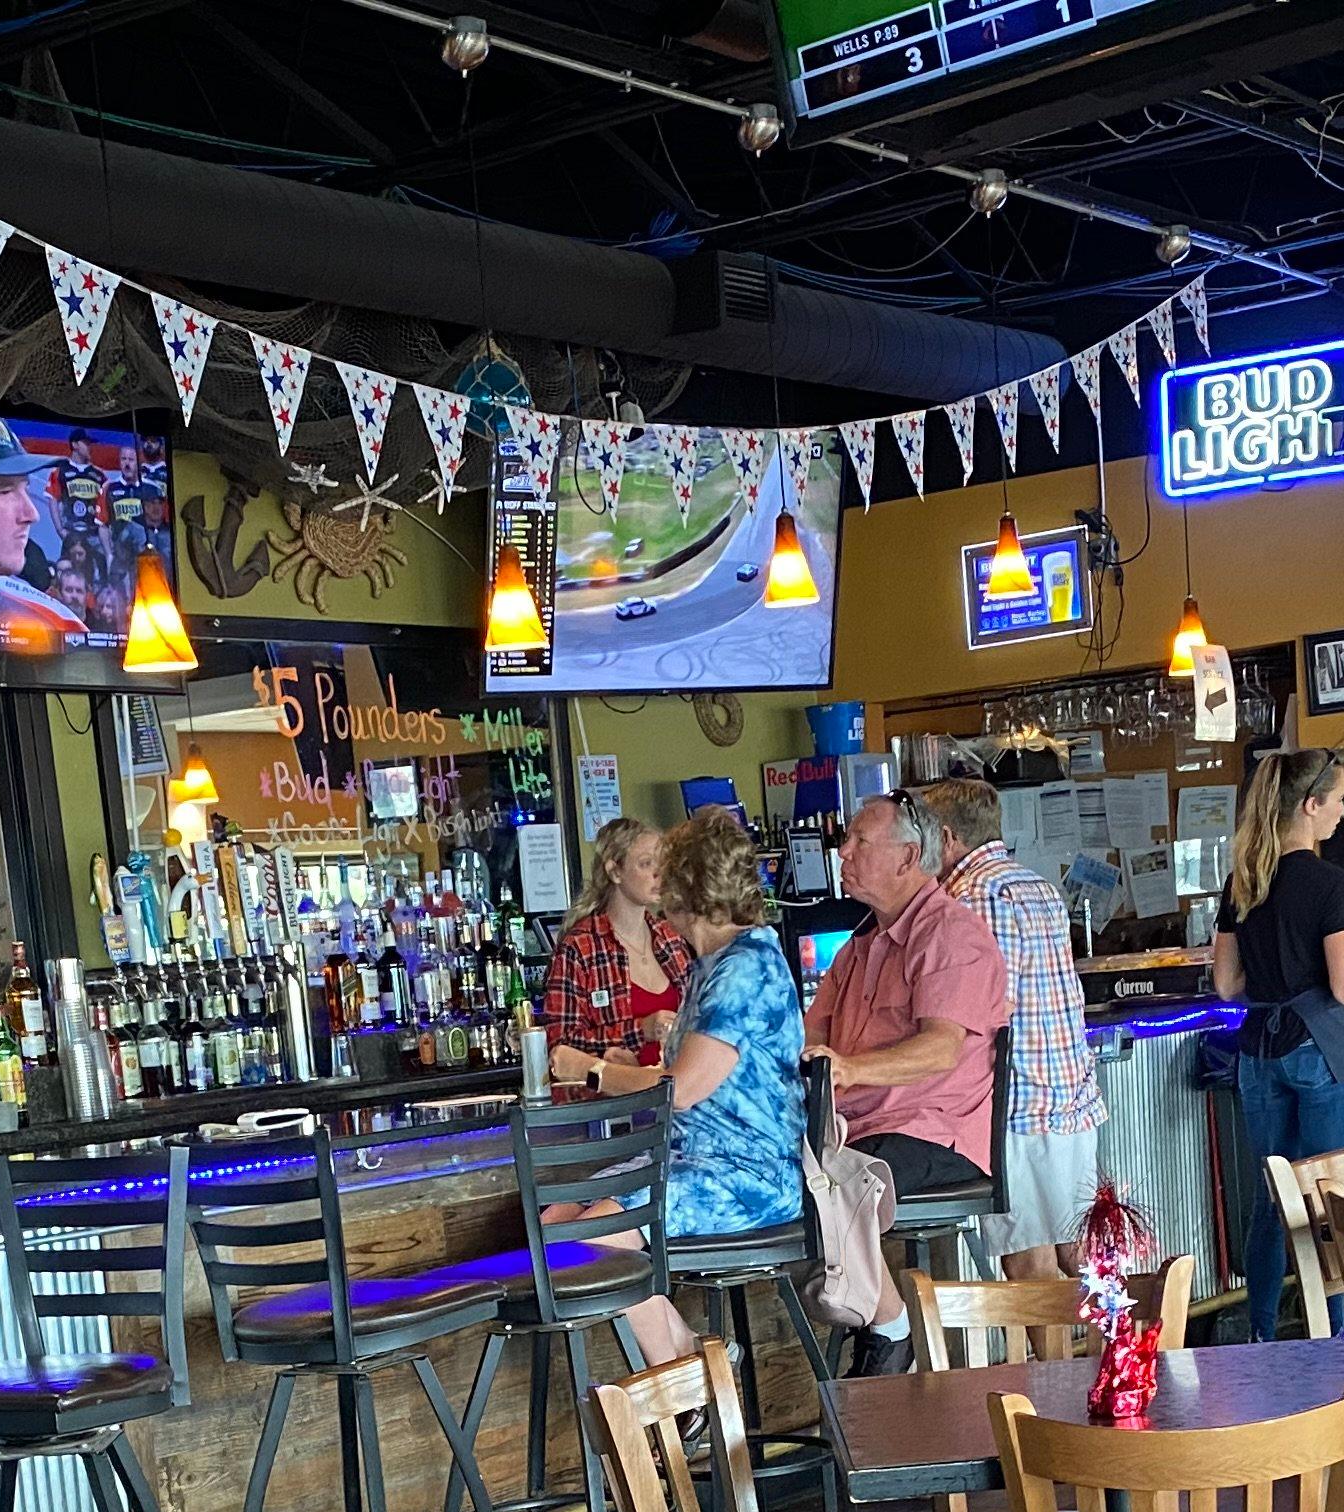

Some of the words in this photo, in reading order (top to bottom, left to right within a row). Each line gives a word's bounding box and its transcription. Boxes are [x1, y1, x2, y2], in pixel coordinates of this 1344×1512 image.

[833, 33, 869, 58] WELLS
[874, 24, 898, 44] P:89
[904, 46, 924, 73] 3
[1196, 358, 1333, 428] BUD
[252, 665, 304, 738] $5
[314, 671, 446, 744] Pounders
[482, 706, 546, 756] Miller
[273, 750, 332, 810] Bud
[765, 766, 799, 787] Red
[799, 757, 835, 780] Bull
[1114, 977, 1154, 998] Cuervo
